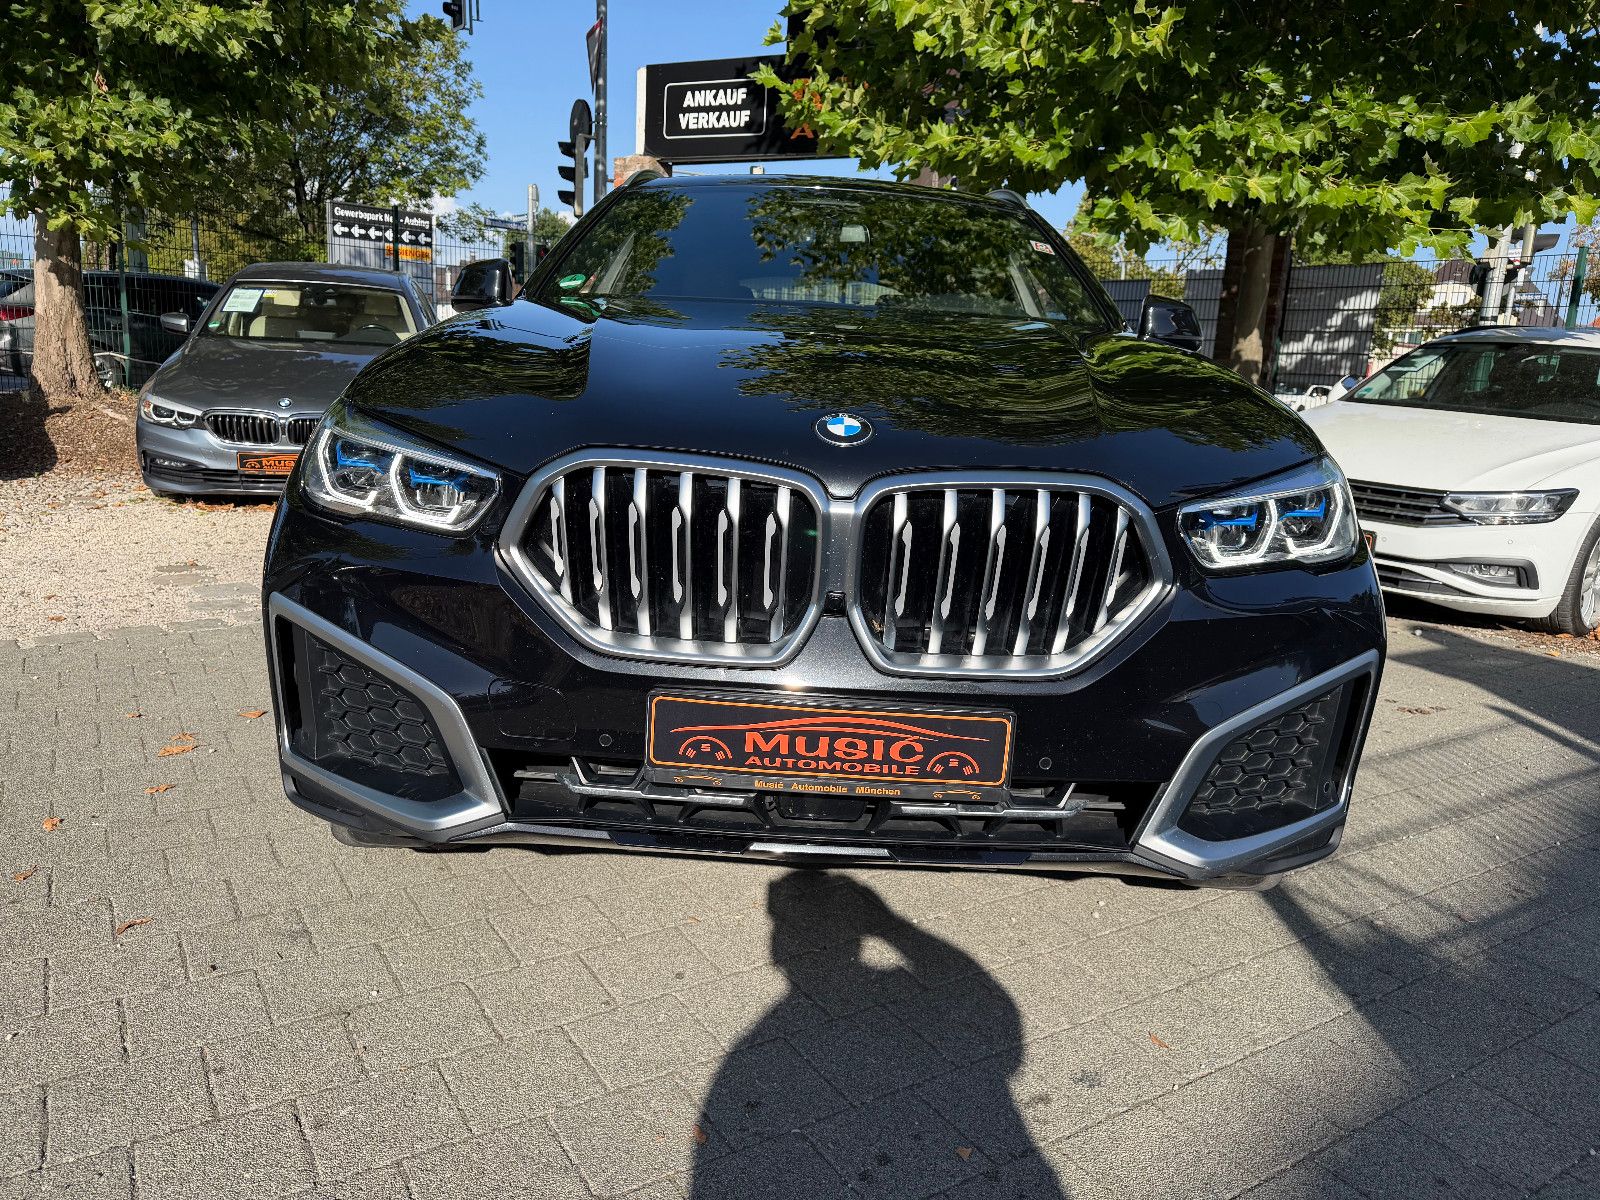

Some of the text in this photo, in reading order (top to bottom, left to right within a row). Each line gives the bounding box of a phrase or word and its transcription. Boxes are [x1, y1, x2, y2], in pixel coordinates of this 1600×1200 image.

[683, 88, 748, 108] ANKAUF
[678, 110, 751, 130] VERKAUF
[744, 755, 921, 775] AUTOMOBILE
[791, 782, 848, 794] Automobile
[855, 785, 901, 796] München
